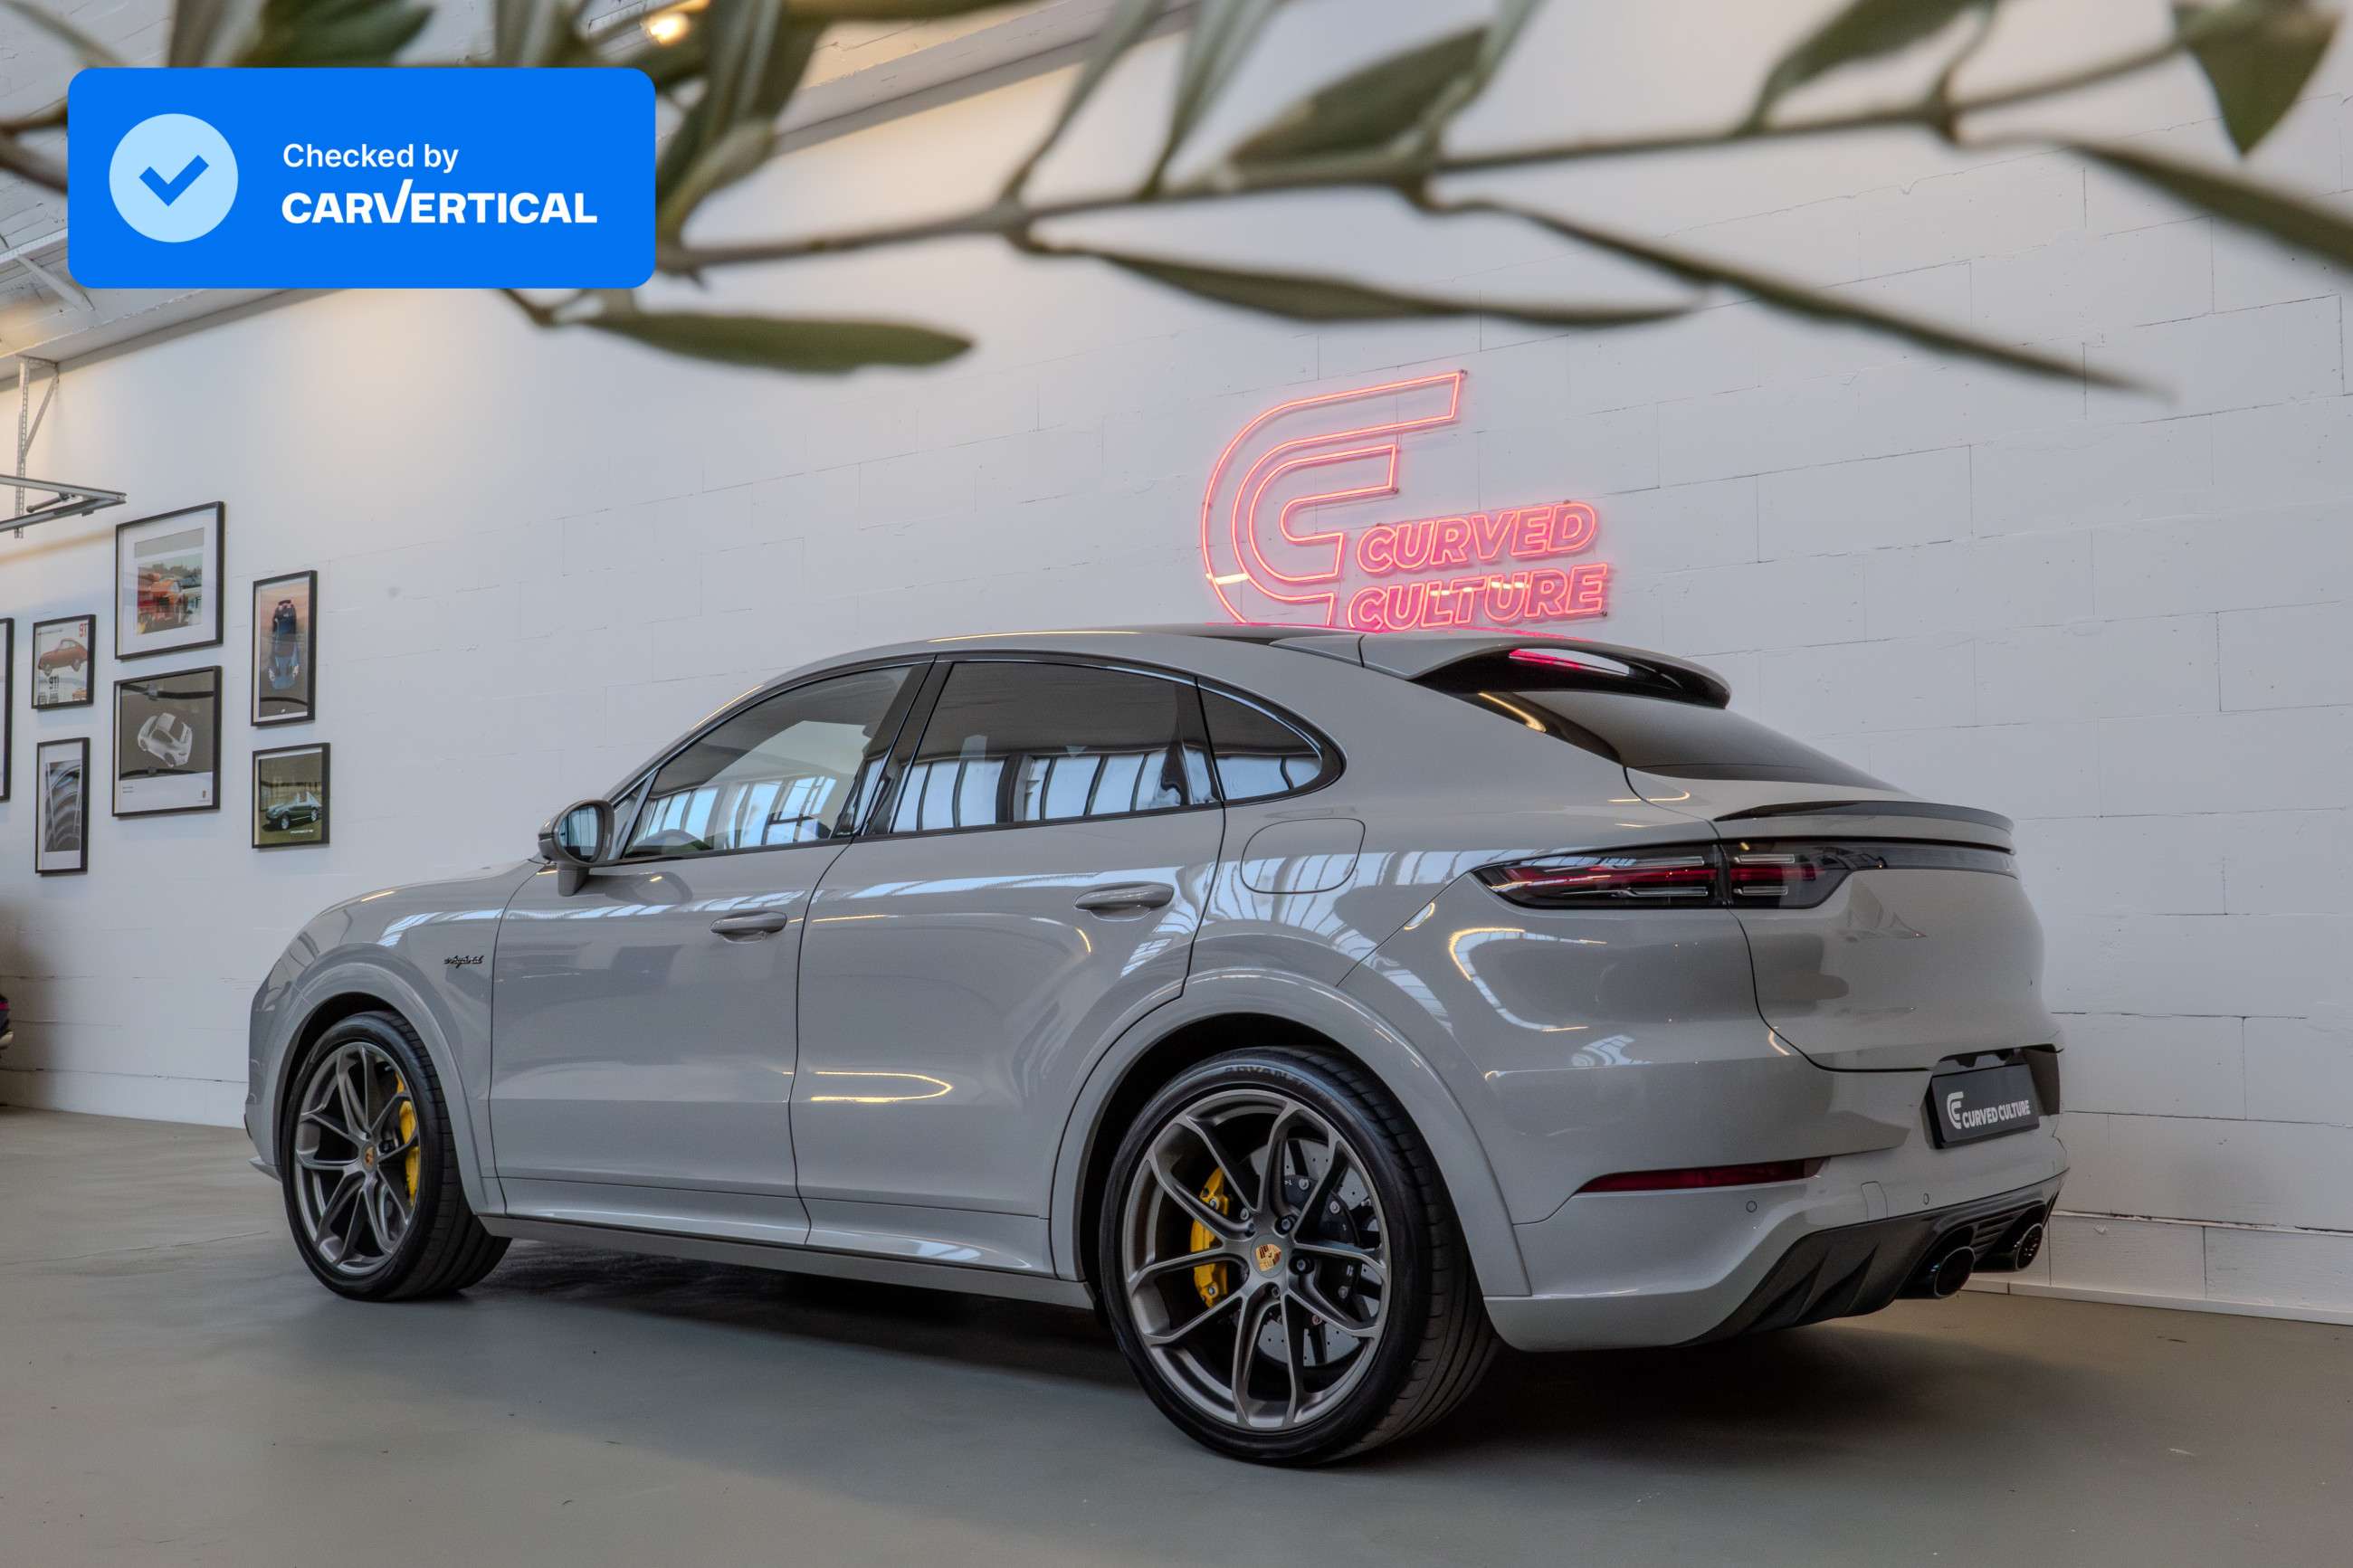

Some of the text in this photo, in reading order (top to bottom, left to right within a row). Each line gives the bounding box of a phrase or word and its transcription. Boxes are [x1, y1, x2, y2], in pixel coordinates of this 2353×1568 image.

[1357, 502, 1596, 573] CURVED
[1348, 563, 1608, 632] CULTURE
[1962, 1099, 2031, 1129] CURVED CULTURE
